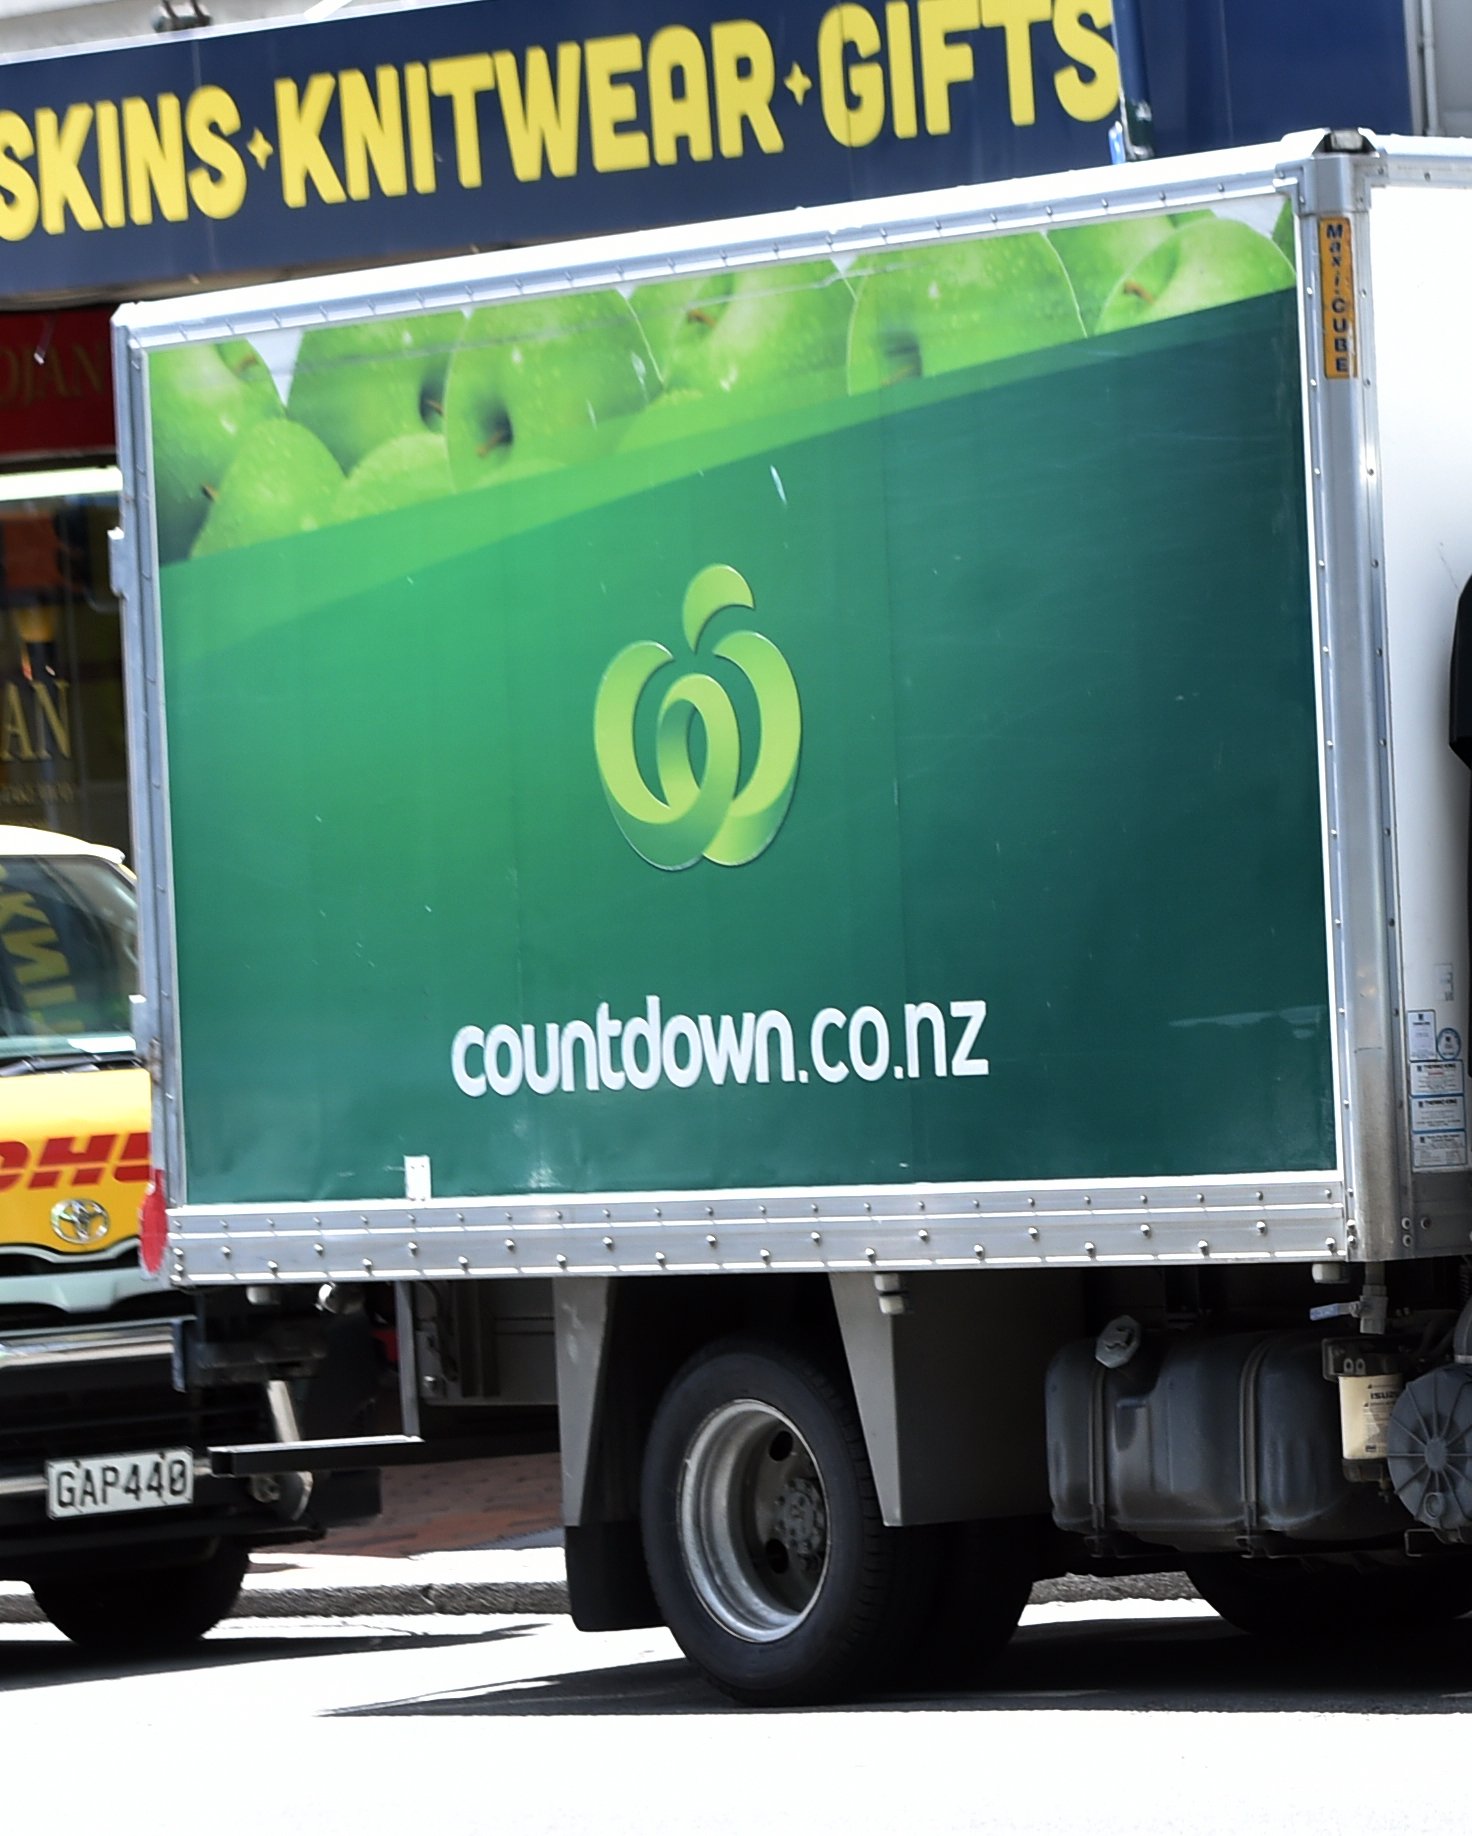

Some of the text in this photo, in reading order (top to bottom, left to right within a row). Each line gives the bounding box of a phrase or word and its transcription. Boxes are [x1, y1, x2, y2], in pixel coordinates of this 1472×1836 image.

[0, 0, 1121, 241] SKINS KNITWEAR GIFTS
[451, 995, 990, 1097] countdown.co.nz
[57, 1458, 187, 1509] GAP440
